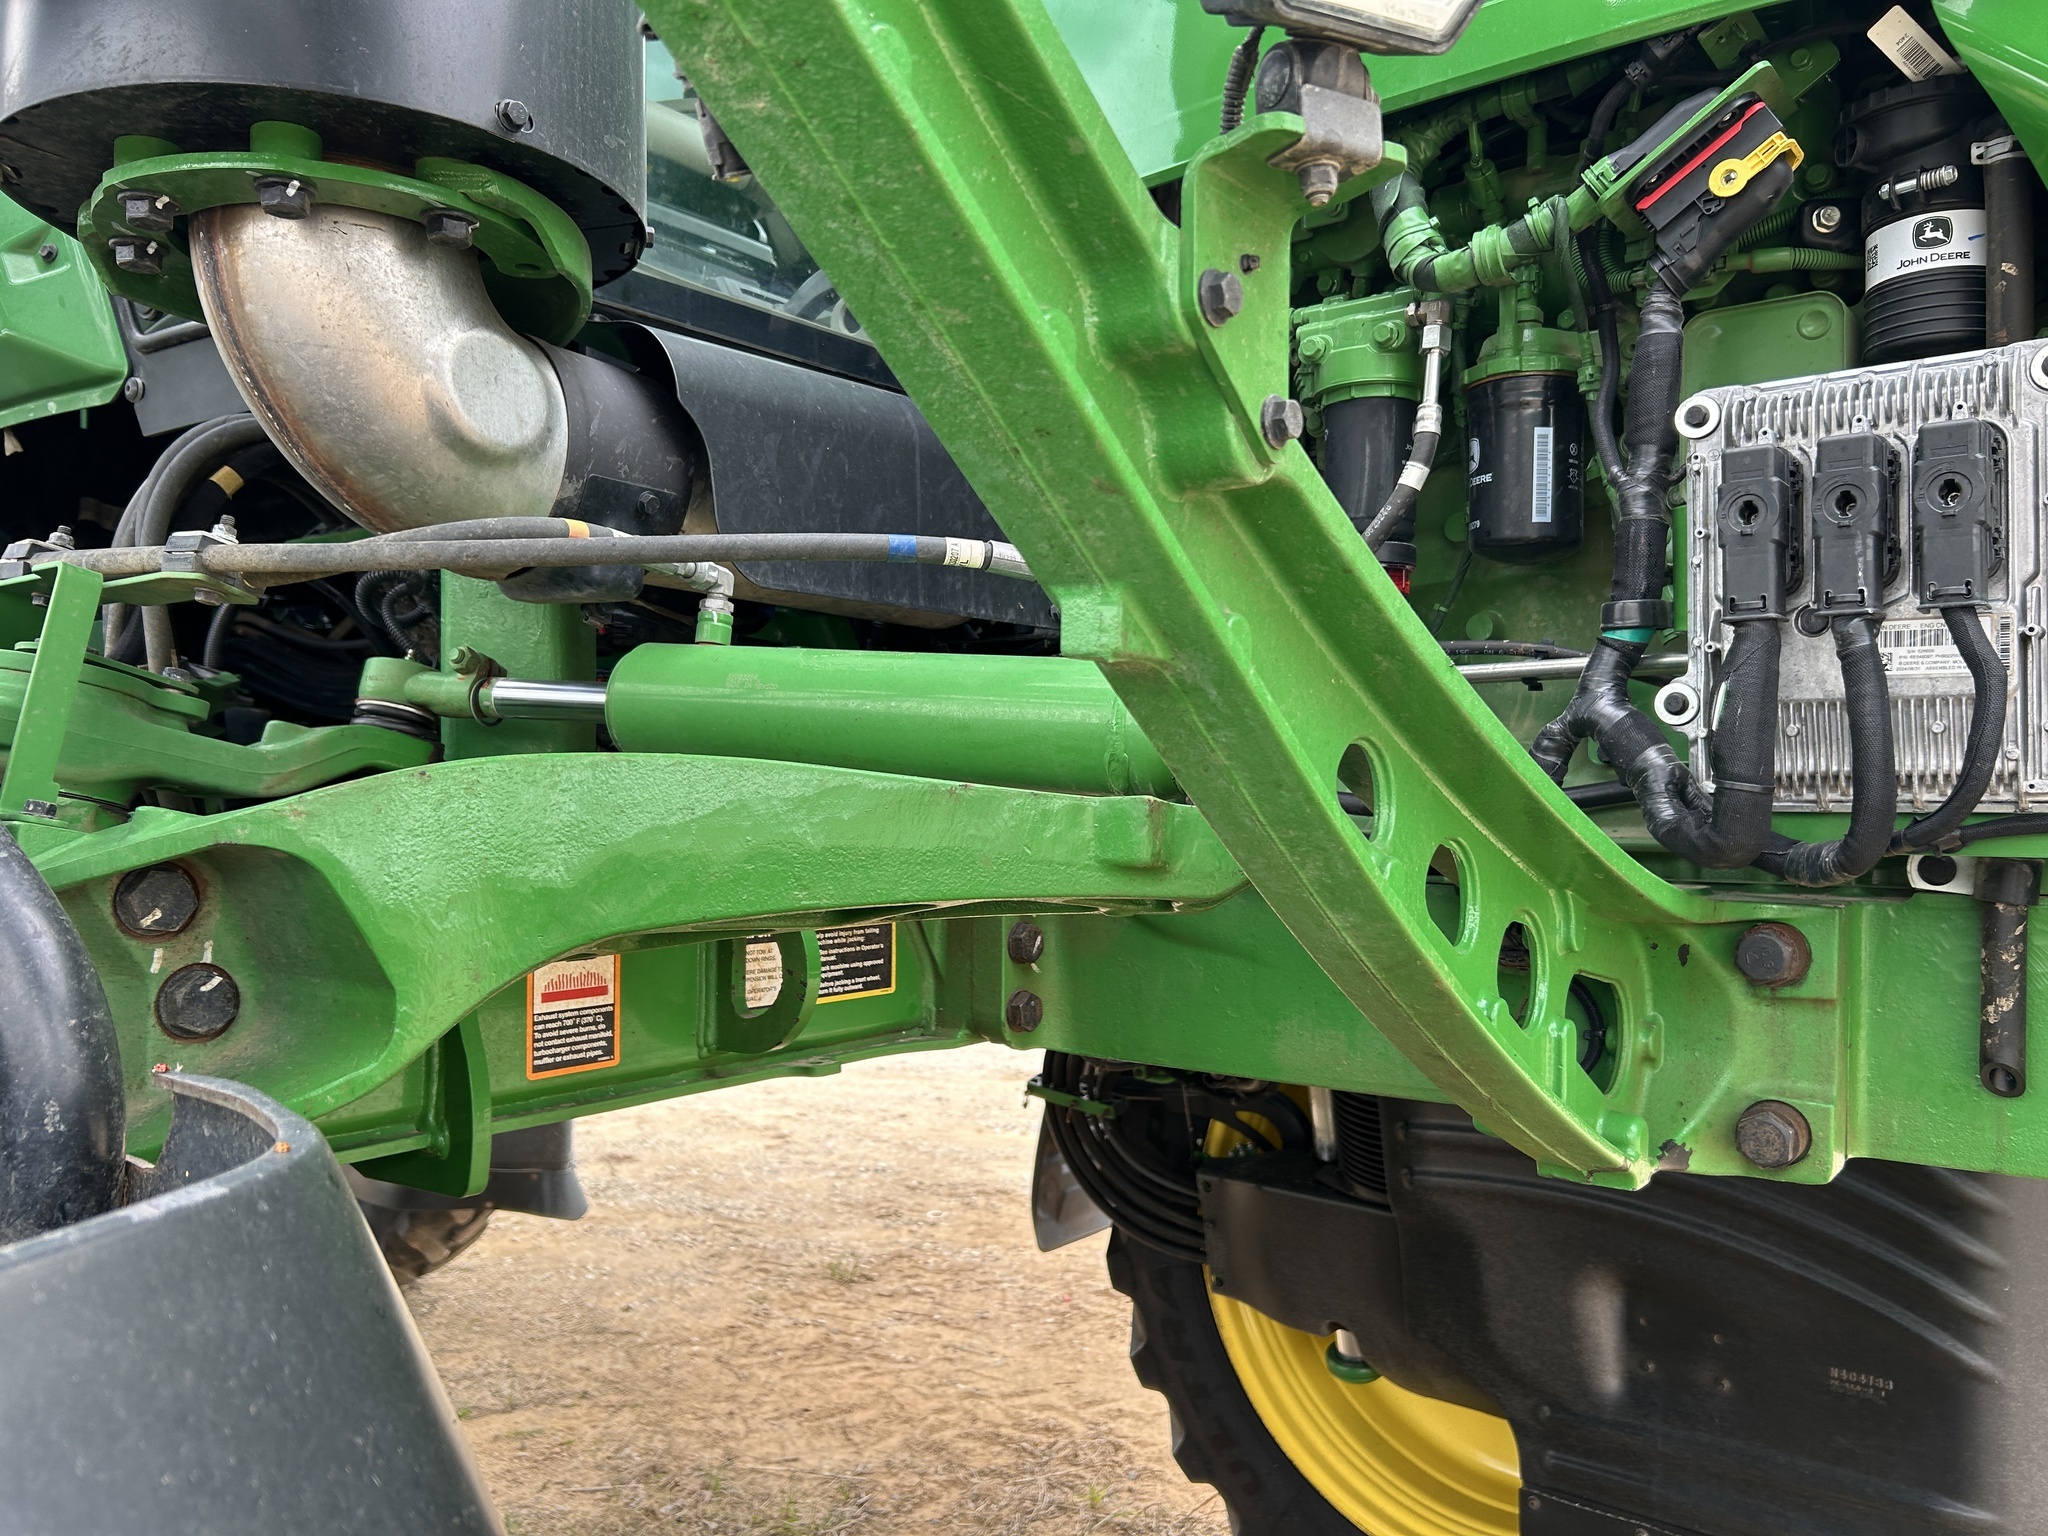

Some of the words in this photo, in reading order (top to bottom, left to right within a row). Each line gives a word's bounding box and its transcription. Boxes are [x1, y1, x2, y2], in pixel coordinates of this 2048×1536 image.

[1897, 256, 1928, 270] JOHN
[1930, 252, 1970, 262] DEERE
[861, 943, 884, 951] Operator's
[863, 958, 884, 967] approved
[534, 1013, 557, 1021] Exhaust
[558, 1010, 579, 1019] system
[580, 1006, 613, 1015] components
[542, 1030, 558, 1038] avoid
[544, 1038, 565, 1046] contact
[566, 1034, 588, 1043] exhaust
[534, 1046, 571, 1057] turbocharger
[534, 1056, 554, 1065] muffler
[563, 1052, 586, 1060] exhaust
[586, 1050, 603, 1058] pipes.
